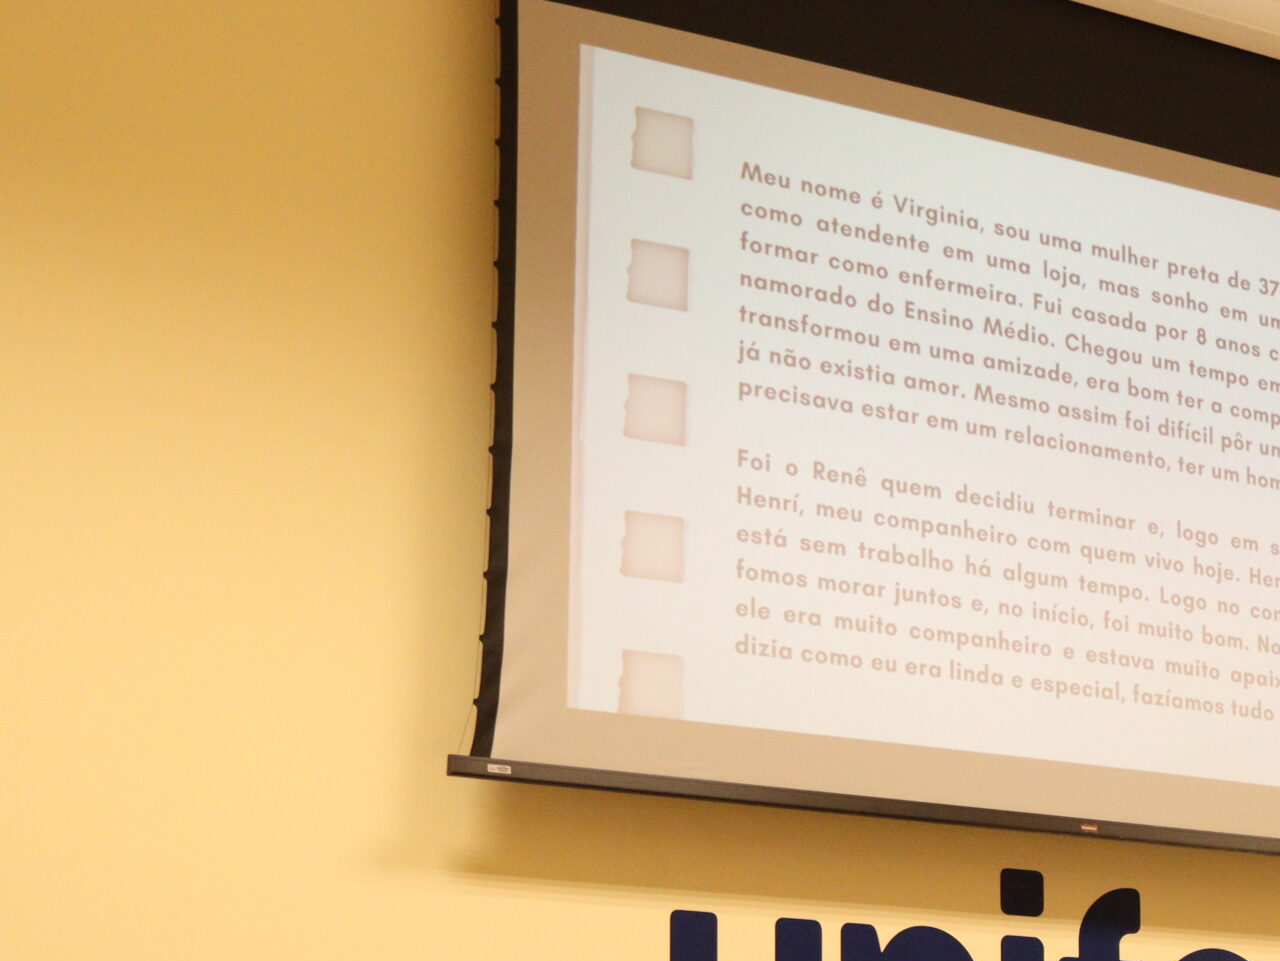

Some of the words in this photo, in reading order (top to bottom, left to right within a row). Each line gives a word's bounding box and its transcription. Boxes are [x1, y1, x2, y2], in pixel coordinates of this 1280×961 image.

[740, 160, 791, 190] Meu
[801, 179, 862, 205] nome
[871, 189, 884, 210] é
[893, 193, 985, 235] Virginia,
[994, 222, 1031, 243] sou
[1039, 231, 1083, 254] uma
[1091, 243, 1160, 271] mulher
[1167, 260, 1220, 285] preta
[1227, 269, 1252, 292] de
[1259, 276, 1280, 298] 37
[740, 202, 804, 228] como
[816, 216, 931, 255] atendente
[942, 245, 975, 264] em
[986, 253, 1031, 276] uma
[1043, 258, 1087, 291] loja,
[1099, 278, 1141, 300] mas
[1151, 290, 1209, 315] sonho
[1219, 305, 1249, 323] em
[740, 229, 820, 266] formar
[828, 255, 890, 280] como
[898, 267, 1024, 308] enfermeira.
[1033, 291, 1063, 316] Fui
[1071, 305, 1147, 334] casada
[1155, 323, 1189, 343] por
[1196, 326, 1208, 347] 8
[1215, 336, 1262, 358] anos
[740, 272, 858, 309] namorado
[867, 291, 896, 316] do
[905, 299, 975, 332] Ensino
[983, 315, 1056, 349] Médio.
[1065, 332, 1143, 366] Chegou
[1152, 355, 1181, 374] um
[1188, 359, 1250, 390] tempo
[737, 338, 761, 365] já
[769, 347, 812, 371] não
[820, 358, 896, 386] existia
[904, 375, 967, 400] amor.
[974, 382, 1051, 415] Mesmo
[1057, 403, 1118, 427] assim
[1125, 409, 1151, 434] foi
[1157, 416, 1214, 446] difícil
[1221, 431, 1254, 454] pôr
[739, 304, 881, 348] transformou
[888, 337, 922, 356] em
[929, 344, 976, 366] uma
[983, 355, 1079, 389] amizade,
[1086, 375, 1120, 395] era
[1127, 376, 1170, 404] bom
[1176, 389, 1205, 411] ter
[1211, 400, 1223, 415] a
[739, 381, 854, 414] precisava
[861, 403, 920, 425] estar
[926, 414, 959, 433] em
[966, 420, 998, 440] um
[1005, 424, 1171, 473] relacionamento,
[1178, 455, 1206, 477] ter
[1212, 465, 1241, 483] um
[737, 485, 805, 517] Henrí,
[816, 503, 863, 523] meu
[874, 512, 1018, 547] companheiro
[1027, 536, 1071, 555] com
[1080, 544, 1136, 565] quem
[1145, 551, 1185, 573] vivo
[1194, 555, 1241, 585] hoje.
[738, 448, 771, 473] Foi
[786, 462, 799, 477] o
[813, 460, 868, 488] Renê
[881, 477, 942, 500] quem
[955, 482, 1035, 515] decidiu
[1048, 500, 1136, 531] terminar
[1148, 521, 1165, 539] e,
[1177, 519, 1219, 549] logo
[1231, 536, 1259, 553] em
[736, 557, 808, 588] fomos
[818, 576, 887, 598] morar
[894, 581, 963, 610] juntos
[971, 598, 989, 616] e,
[999, 601, 1024, 618] no
[1033, 600, 1095, 630] início,
[1104, 609, 1129, 633] foi
[1139, 621, 1194, 643] muito
[1202, 624, 1249, 651] bom.
[737, 527, 788, 549] está
[800, 537, 847, 557] sem
[858, 541, 954, 573] trabalho
[966, 553, 992, 578] há
[1003, 561, 1068, 590] algum
[1079, 574, 1149, 604] tempo.
[1160, 585, 1207, 614] Logo
[1218, 600, 1240, 616] no
[735, 633, 793, 660] dizia
[801, 648, 863, 669] como
[871, 657, 897, 673] eu
[905, 661, 942, 678] era
[950, 659, 1004, 686] linda
[1012, 674, 1024, 689] e
[1031, 677, 1126, 704] especial,
[1133, 683, 1225, 715] fazíamos
[1231, 699, 1275, 721] tudo
[736, 596, 771, 621] ele
[784, 609, 822, 627] era
[835, 614, 898, 637] muito
[910, 625, 1052, 657] companheiro
[1064, 646, 1075, 660] e
[1086, 648, 1155, 671] estava
[1166, 659, 1221, 680] muito
